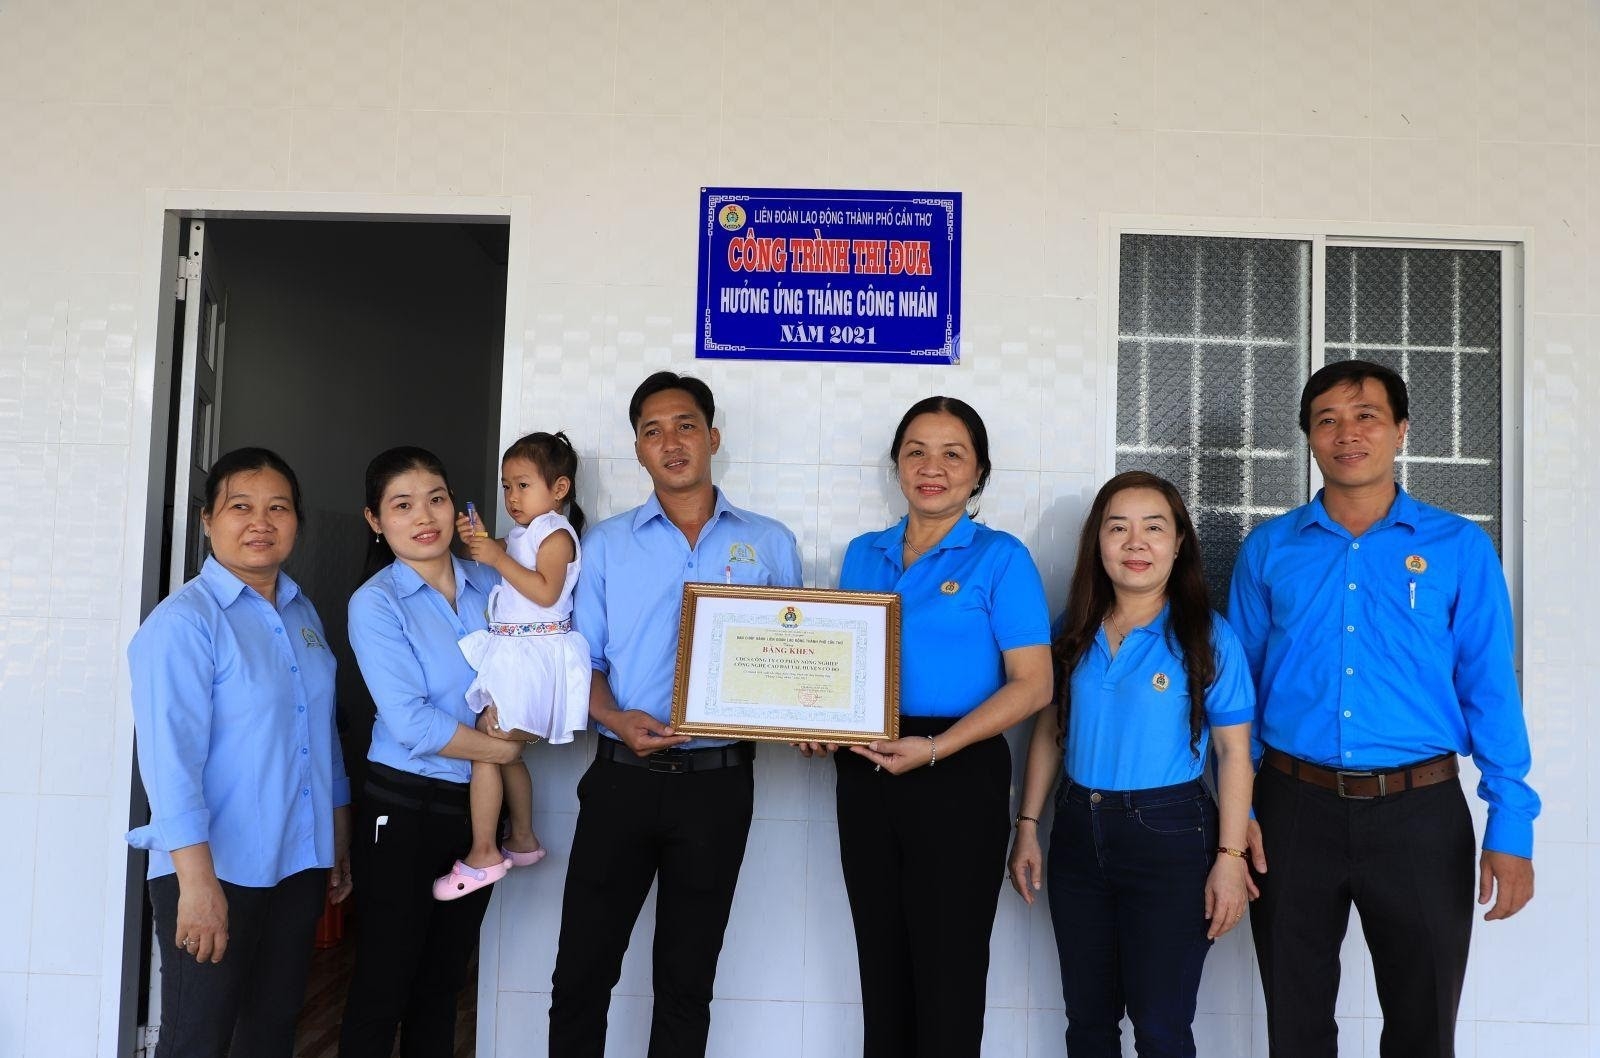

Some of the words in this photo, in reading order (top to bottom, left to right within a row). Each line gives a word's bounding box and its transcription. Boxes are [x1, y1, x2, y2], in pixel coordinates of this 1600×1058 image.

[754, 206, 773, 223] LIÊN
[774, 206, 799, 224] ĐOÀN
[800, 210, 817, 224] LAO
[819, 207, 844, 228] ĐỘNG
[846, 207, 874, 225] THÀNH
[875, 206, 893, 226] PHỐ
[914, 212, 933, 227] THƠ
[728, 227, 787, 272] CÔNG
[790, 228, 850, 274] TRÌNH
[852, 239, 887, 275] THI
[889, 240, 932, 276] ĐUA
[720, 279, 770, 314] HƯỞNG
[773, 281, 803, 315] ỨNG
[807, 282, 853, 316] THÁNG
[856, 283, 895, 317] CÔNG
[898, 285, 938, 318] NHÂN
[780, 320, 825, 343] NĂM
[829, 325, 877, 345] 2021
[789, 647, 816, 655] KHEN
